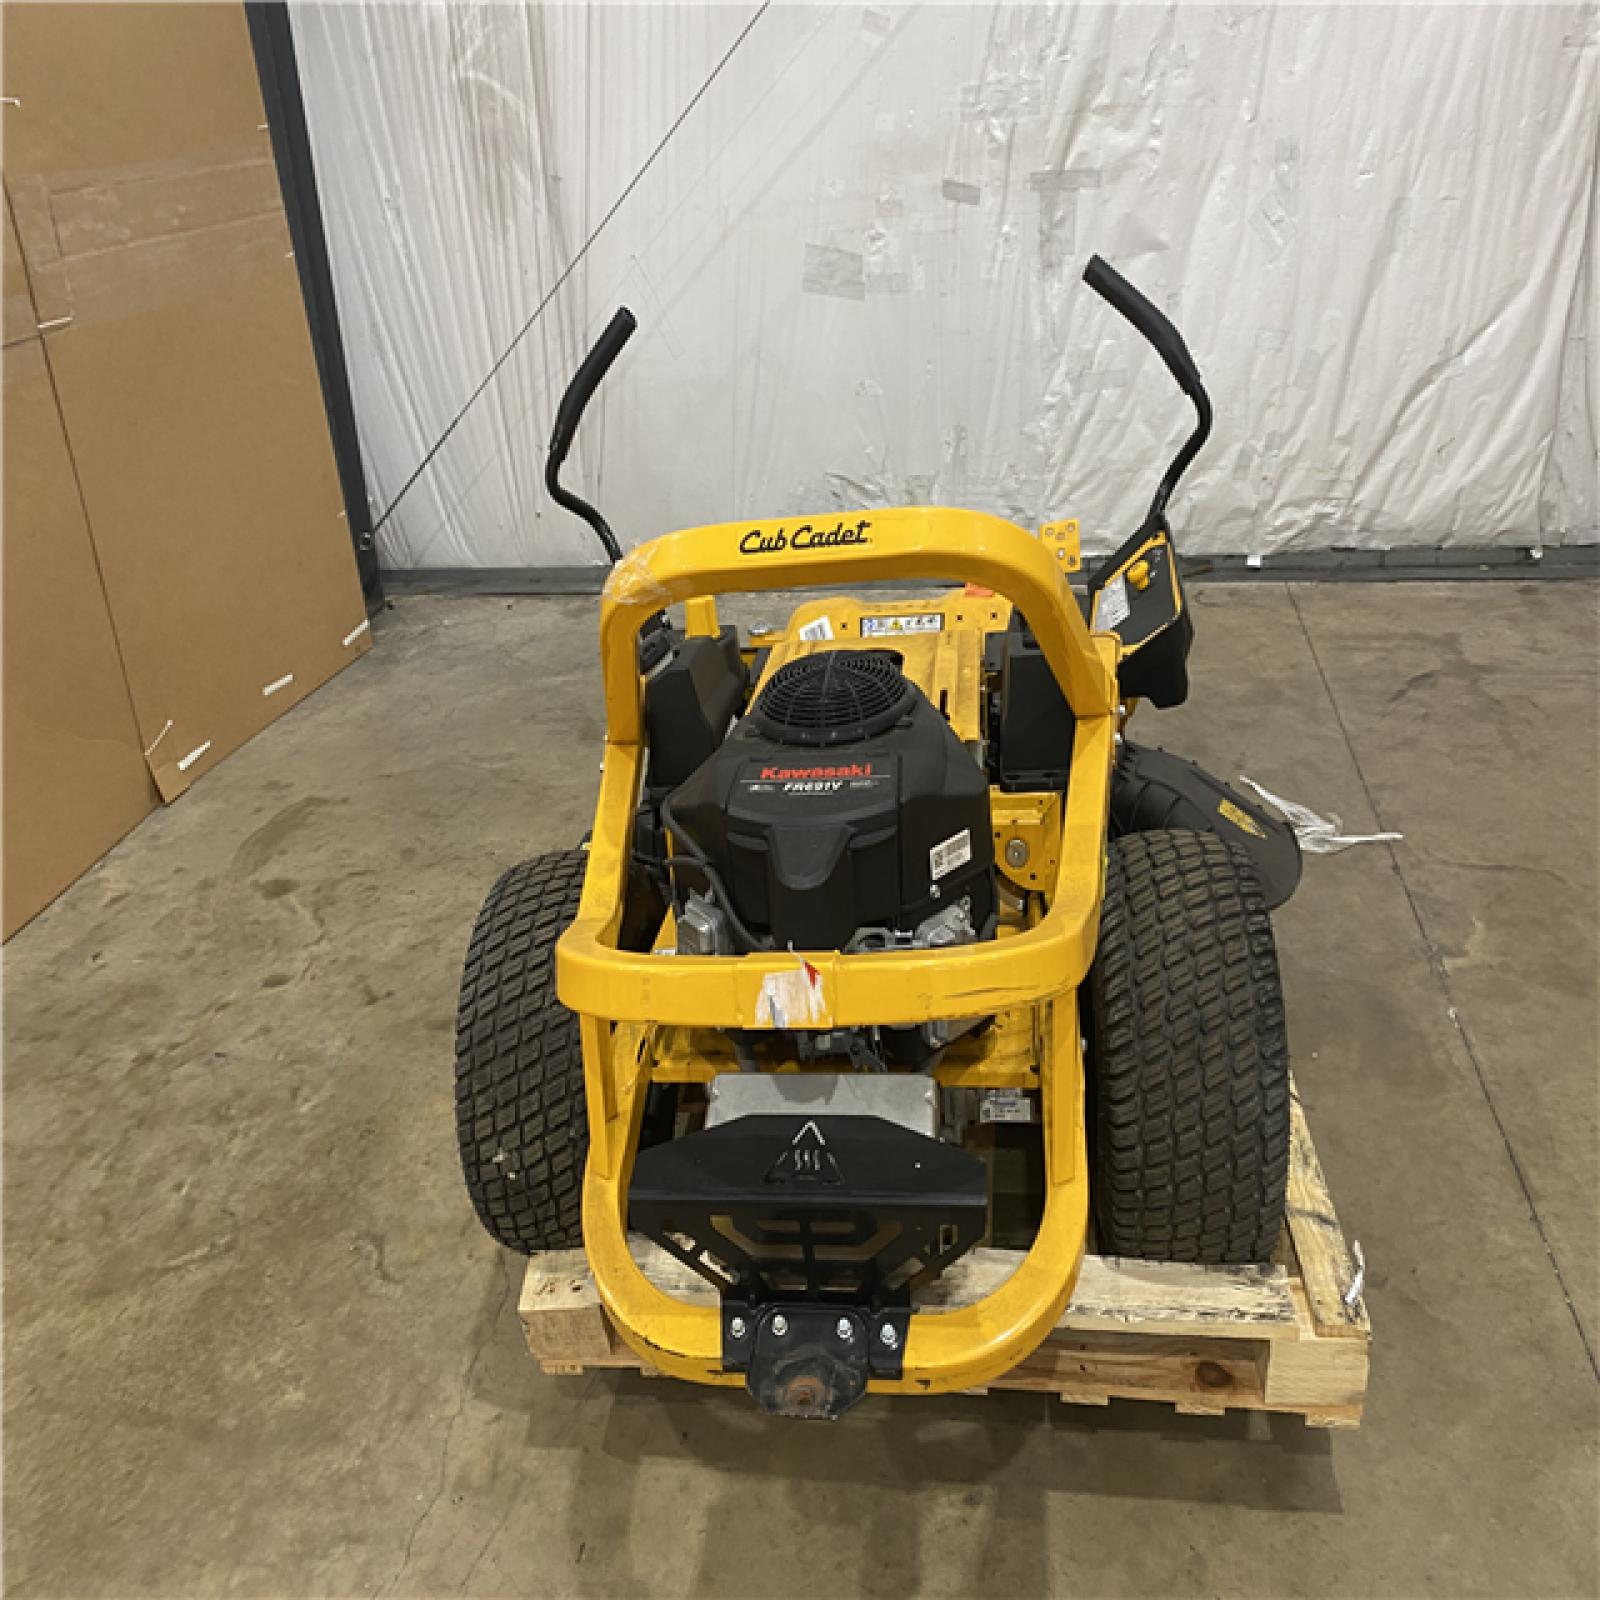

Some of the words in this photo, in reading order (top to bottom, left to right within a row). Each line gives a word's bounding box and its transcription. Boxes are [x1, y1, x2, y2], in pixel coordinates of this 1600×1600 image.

[740, 528, 786, 553] Cub
[790, 520, 870, 549] Cadet
[760, 762, 872, 780] Kawasaki
